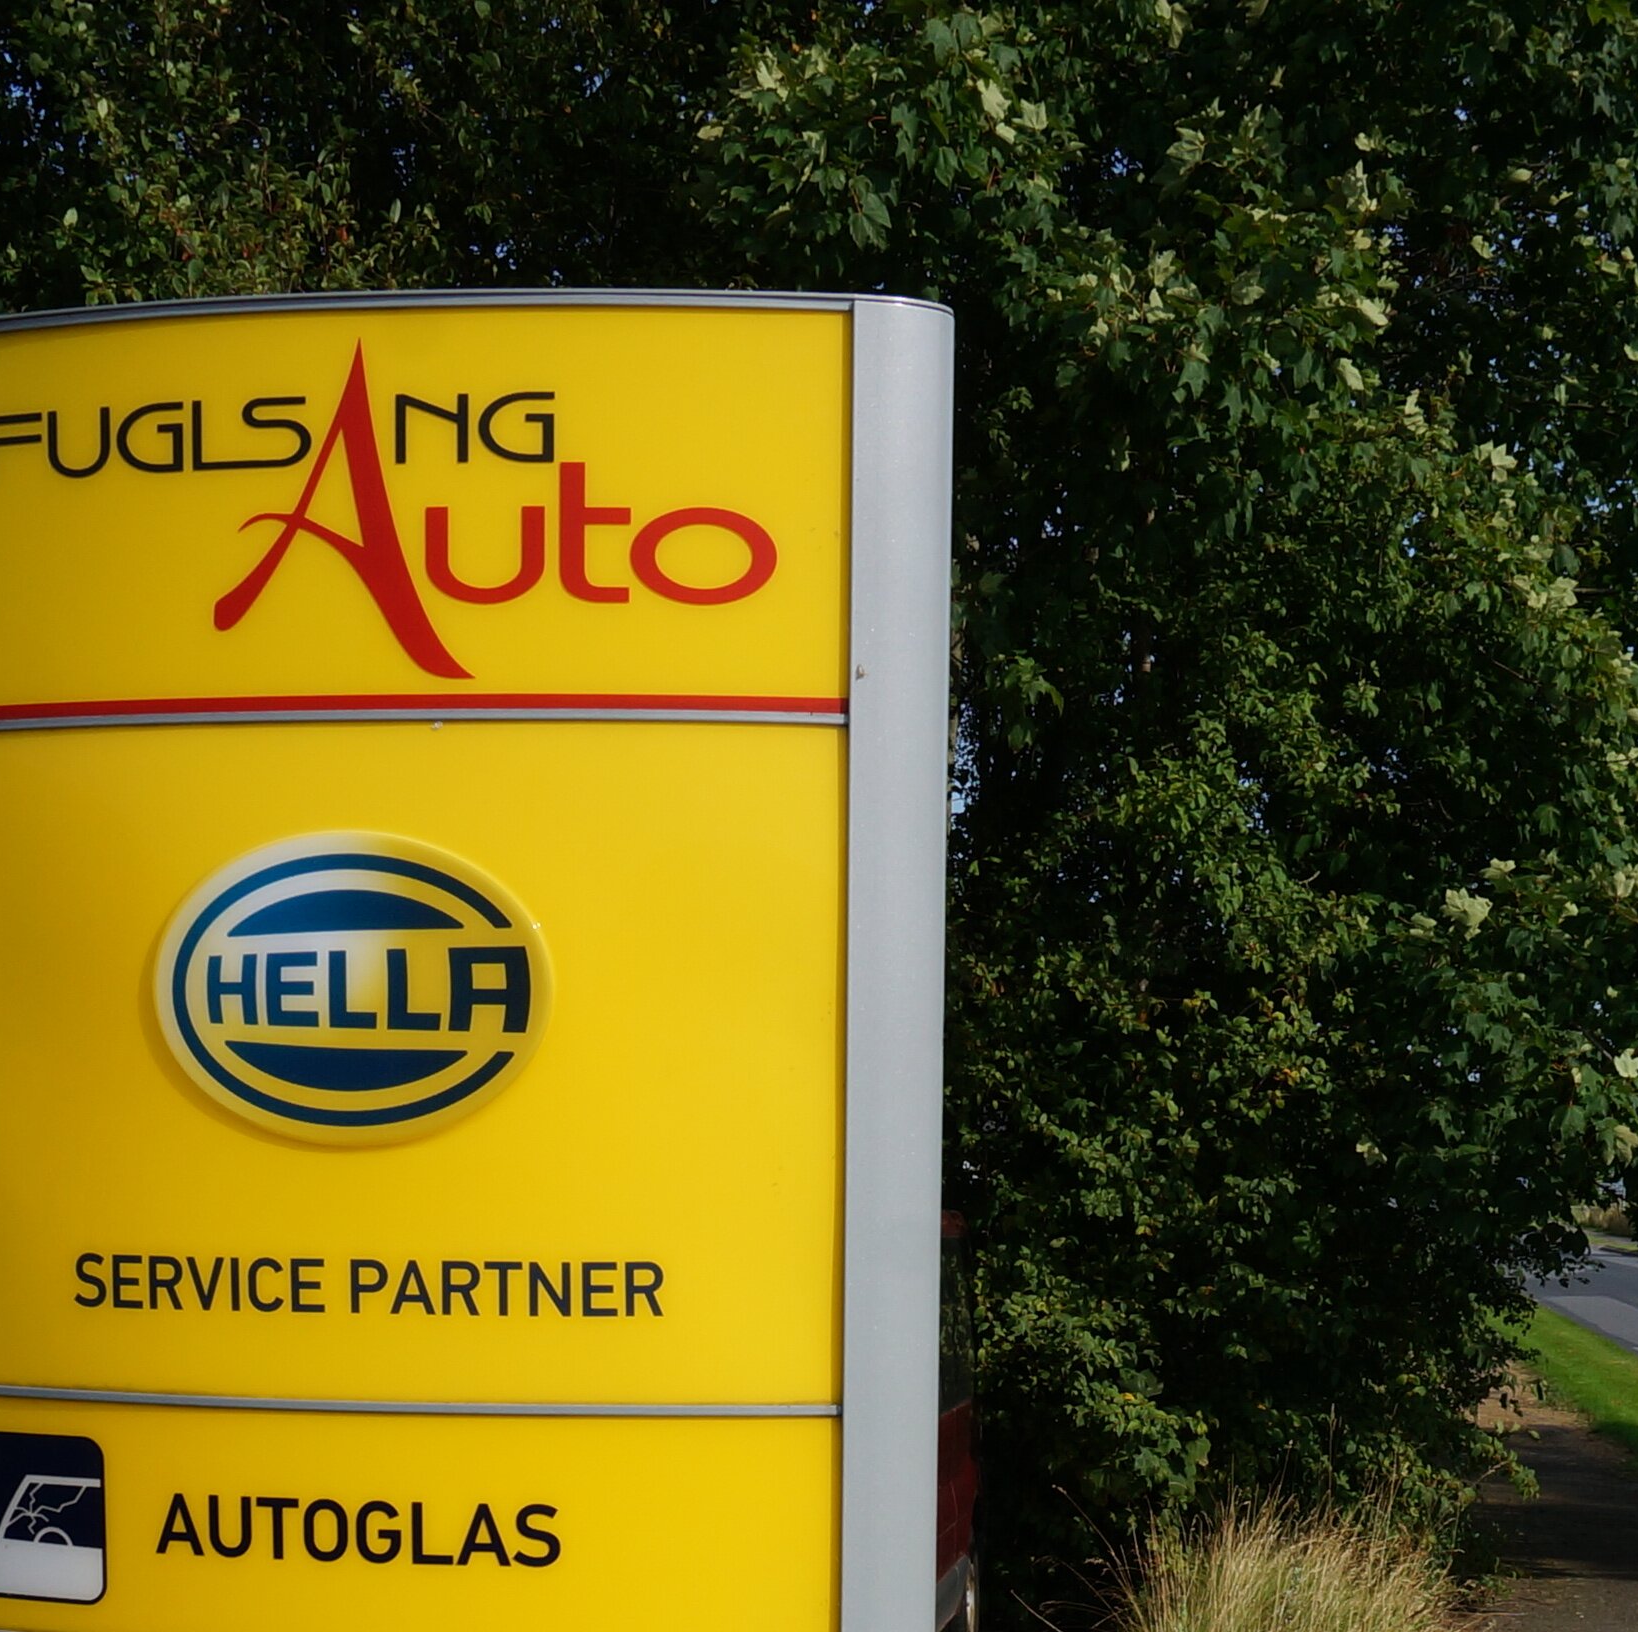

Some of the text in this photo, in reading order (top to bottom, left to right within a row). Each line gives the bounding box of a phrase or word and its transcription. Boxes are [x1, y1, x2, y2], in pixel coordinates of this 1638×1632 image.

[213, 338, 777, 679] Auto
[206, 945, 531, 1034] HELLA
[74, 1252, 665, 1318] SERVICE PARTNER
[155, 1492, 562, 1568] AUTOGLAS
